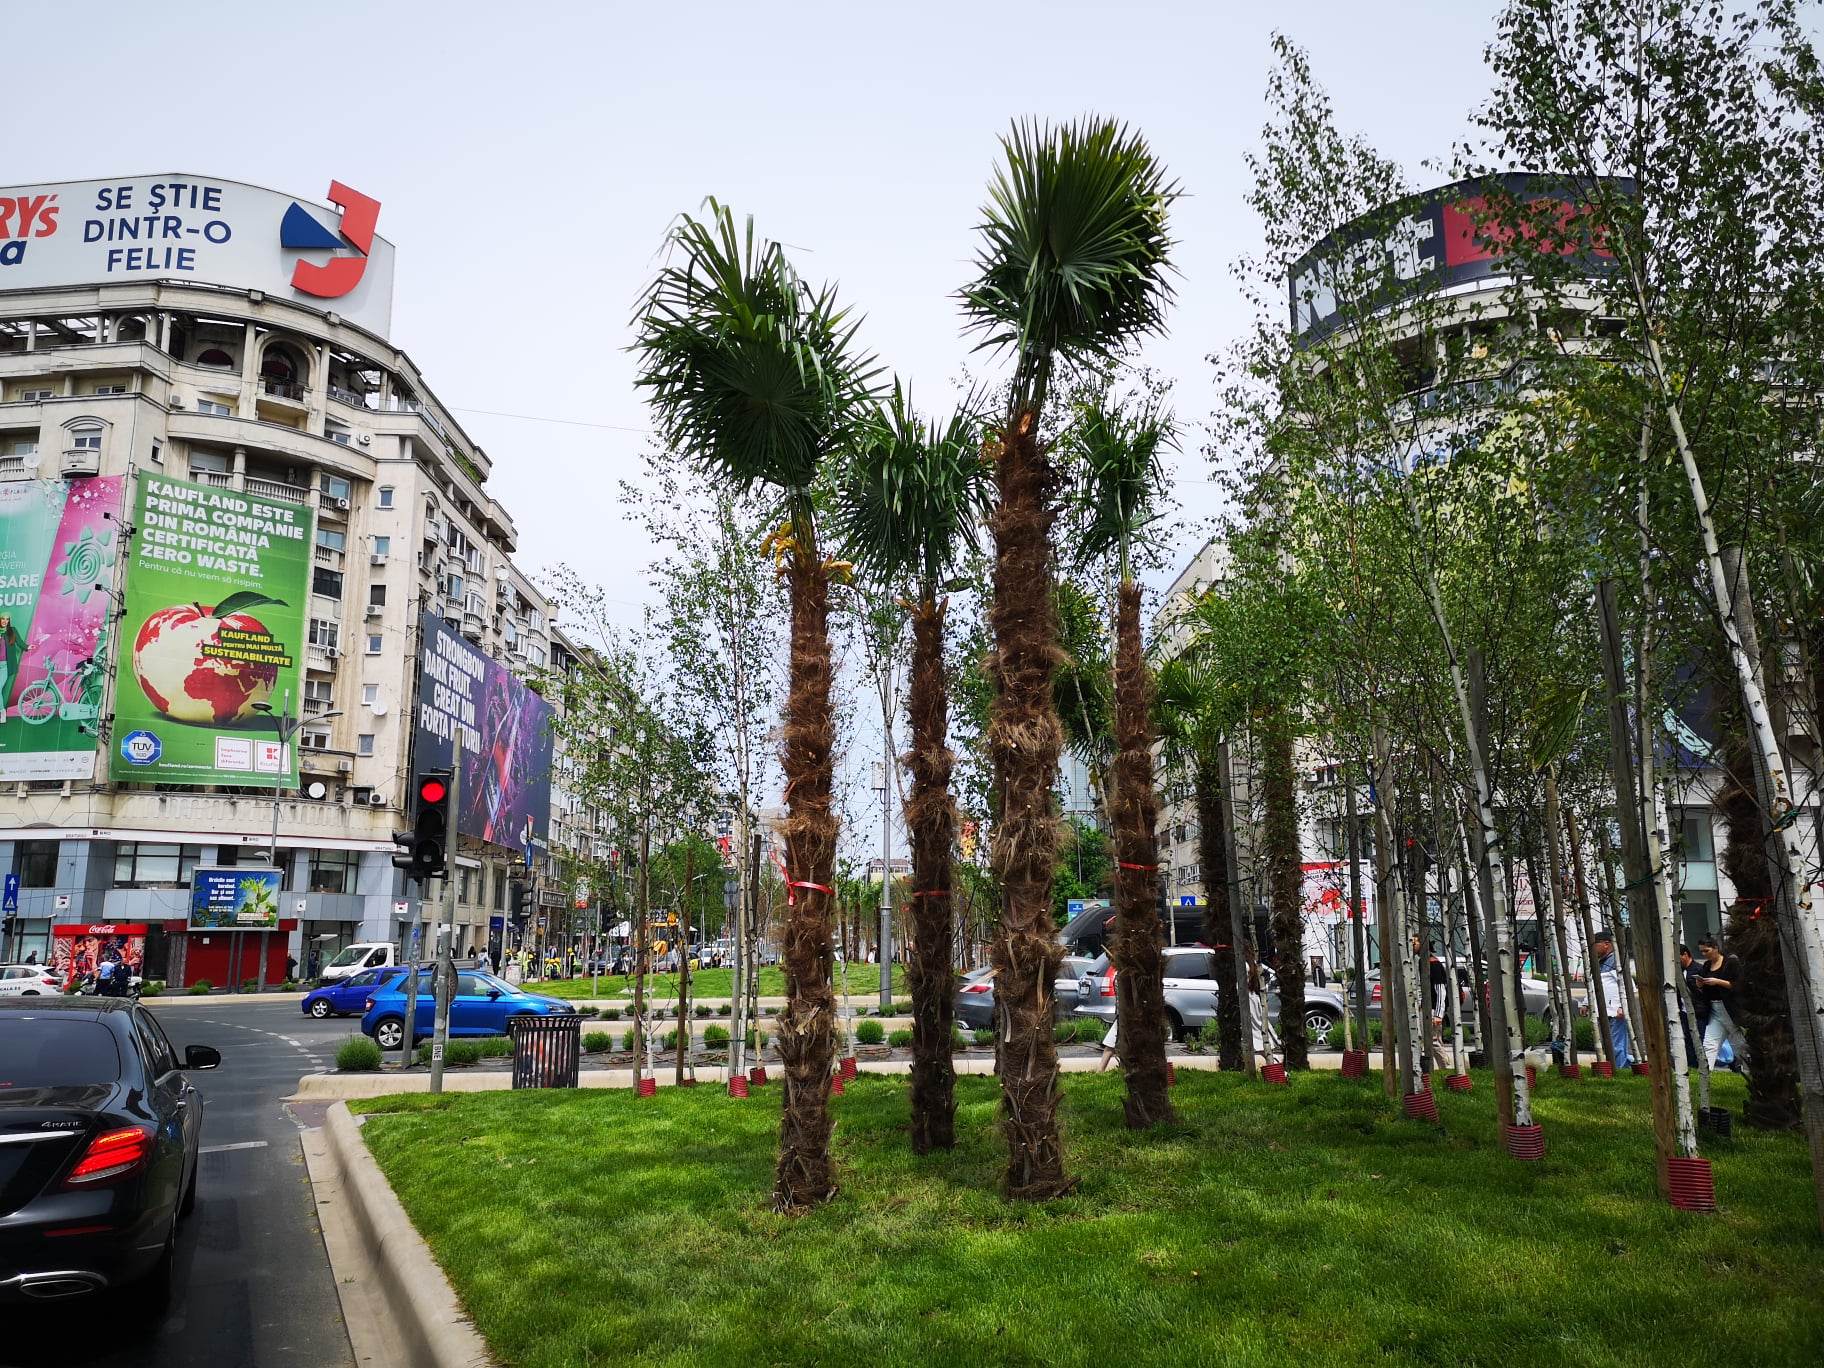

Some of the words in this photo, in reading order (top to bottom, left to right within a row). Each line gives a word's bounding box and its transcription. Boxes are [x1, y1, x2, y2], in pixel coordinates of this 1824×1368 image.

[95, 185, 133, 212] SE
[83, 215, 232, 244] DINTR-O
[107, 247, 196, 273] FELIE
[146, 496, 207, 521] PRIMA
[212, 508, 304, 540] COMPANIE
[147, 480, 248, 513] KAUFLAND
[252, 503, 294, 523] ESTE
[142, 528, 259, 561] CERTIFICATĂ
[144, 511, 178, 530] DIN
[182, 520, 270, 548] ROMÂNIA
[139, 560, 169, 572] Pentru
[184, 568, 196, 577] nu
[197, 571, 220, 582] vrem
[140, 543, 192, 564] ZERO
[197, 553, 263, 578] WASTE.
[220, 630, 270, 643] KAUFLAND
[204, 646, 291, 666] SUSTENABILITATE
[436, 629, 485, 683] STRONGBOW
[424, 648, 449, 685] DARK
[449, 664, 472, 699] FRUIT.
[434, 683, 461, 718] CREAT
[461, 698, 476, 726] DIN
